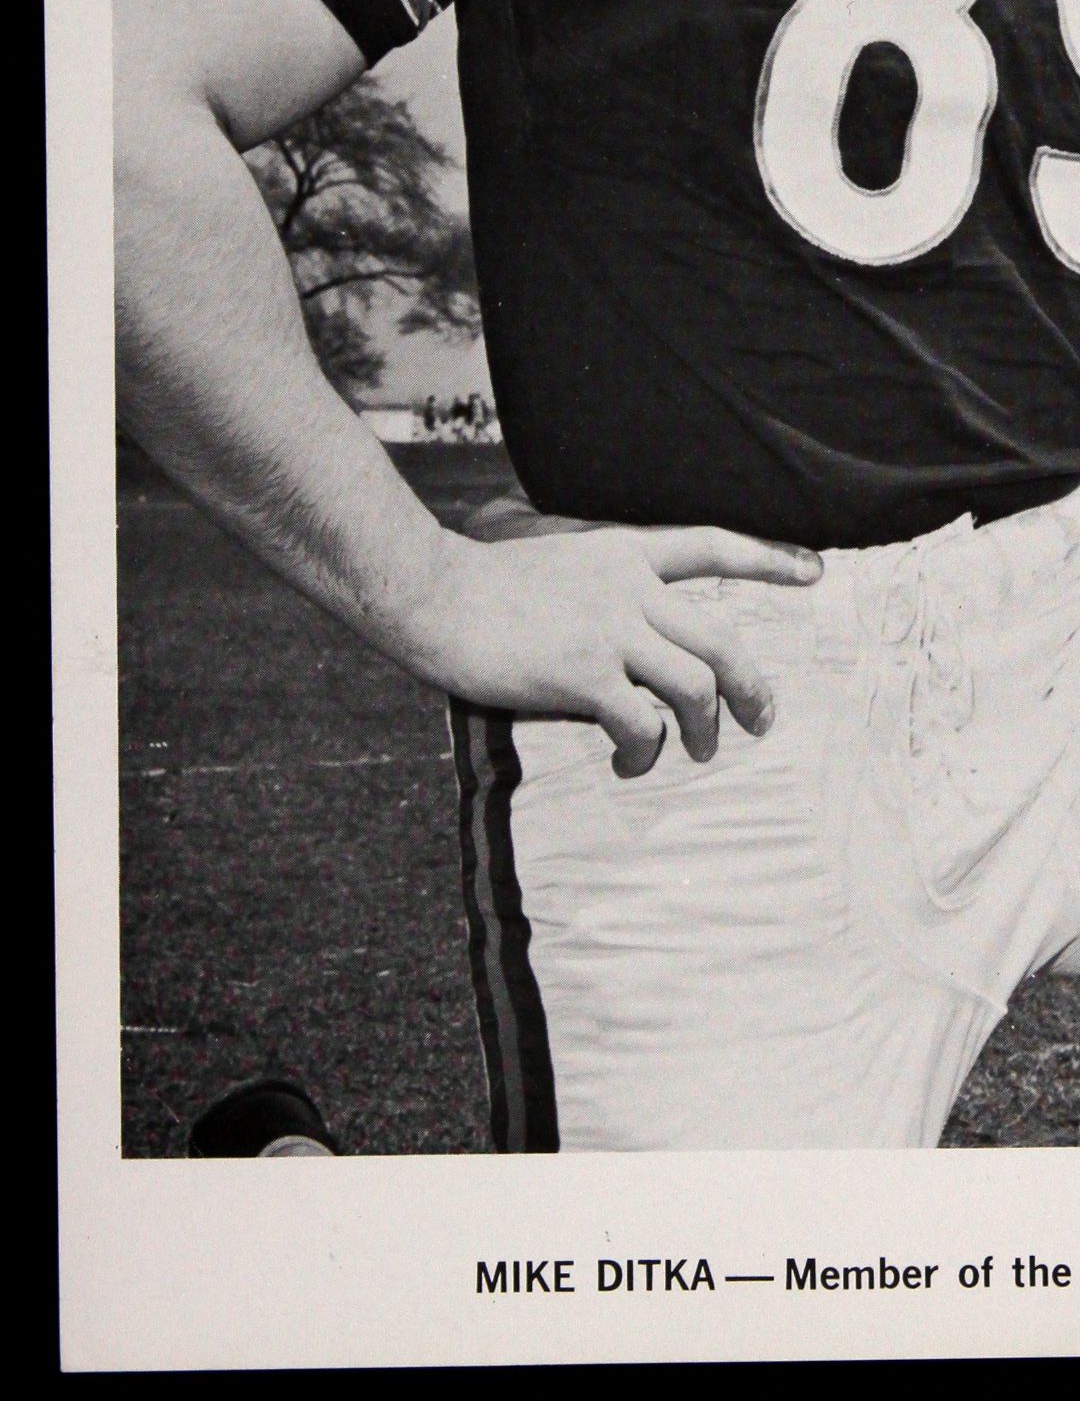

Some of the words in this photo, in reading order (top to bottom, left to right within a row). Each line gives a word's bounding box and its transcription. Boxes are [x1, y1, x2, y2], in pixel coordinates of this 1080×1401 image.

[476, 1260, 575, 1294] MIKE
[598, 1258, 715, 1292] DITKA
[786, 1257, 939, 1290] Member
[958, 1255, 993, 1288] of
[1012, 1255, 1071, 1288] the
